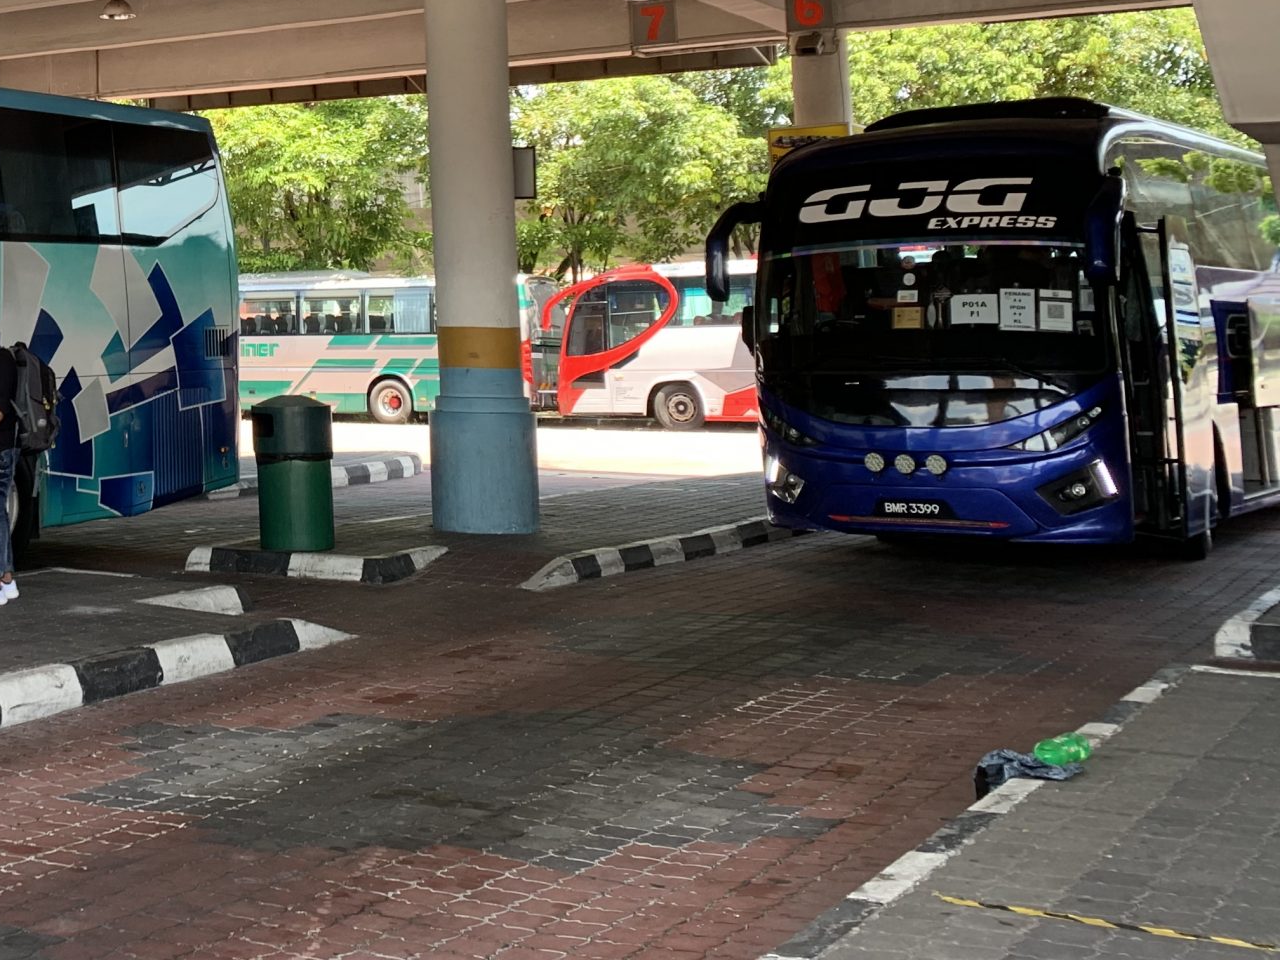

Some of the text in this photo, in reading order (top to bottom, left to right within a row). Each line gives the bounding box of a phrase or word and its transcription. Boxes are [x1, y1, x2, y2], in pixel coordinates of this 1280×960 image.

[640, 5, 666, 40] 7
[800, 177, 1034, 224] GJG
[927, 215, 1058, 230] EXPRESS
[884, 502, 940, 515] BMR 3399
